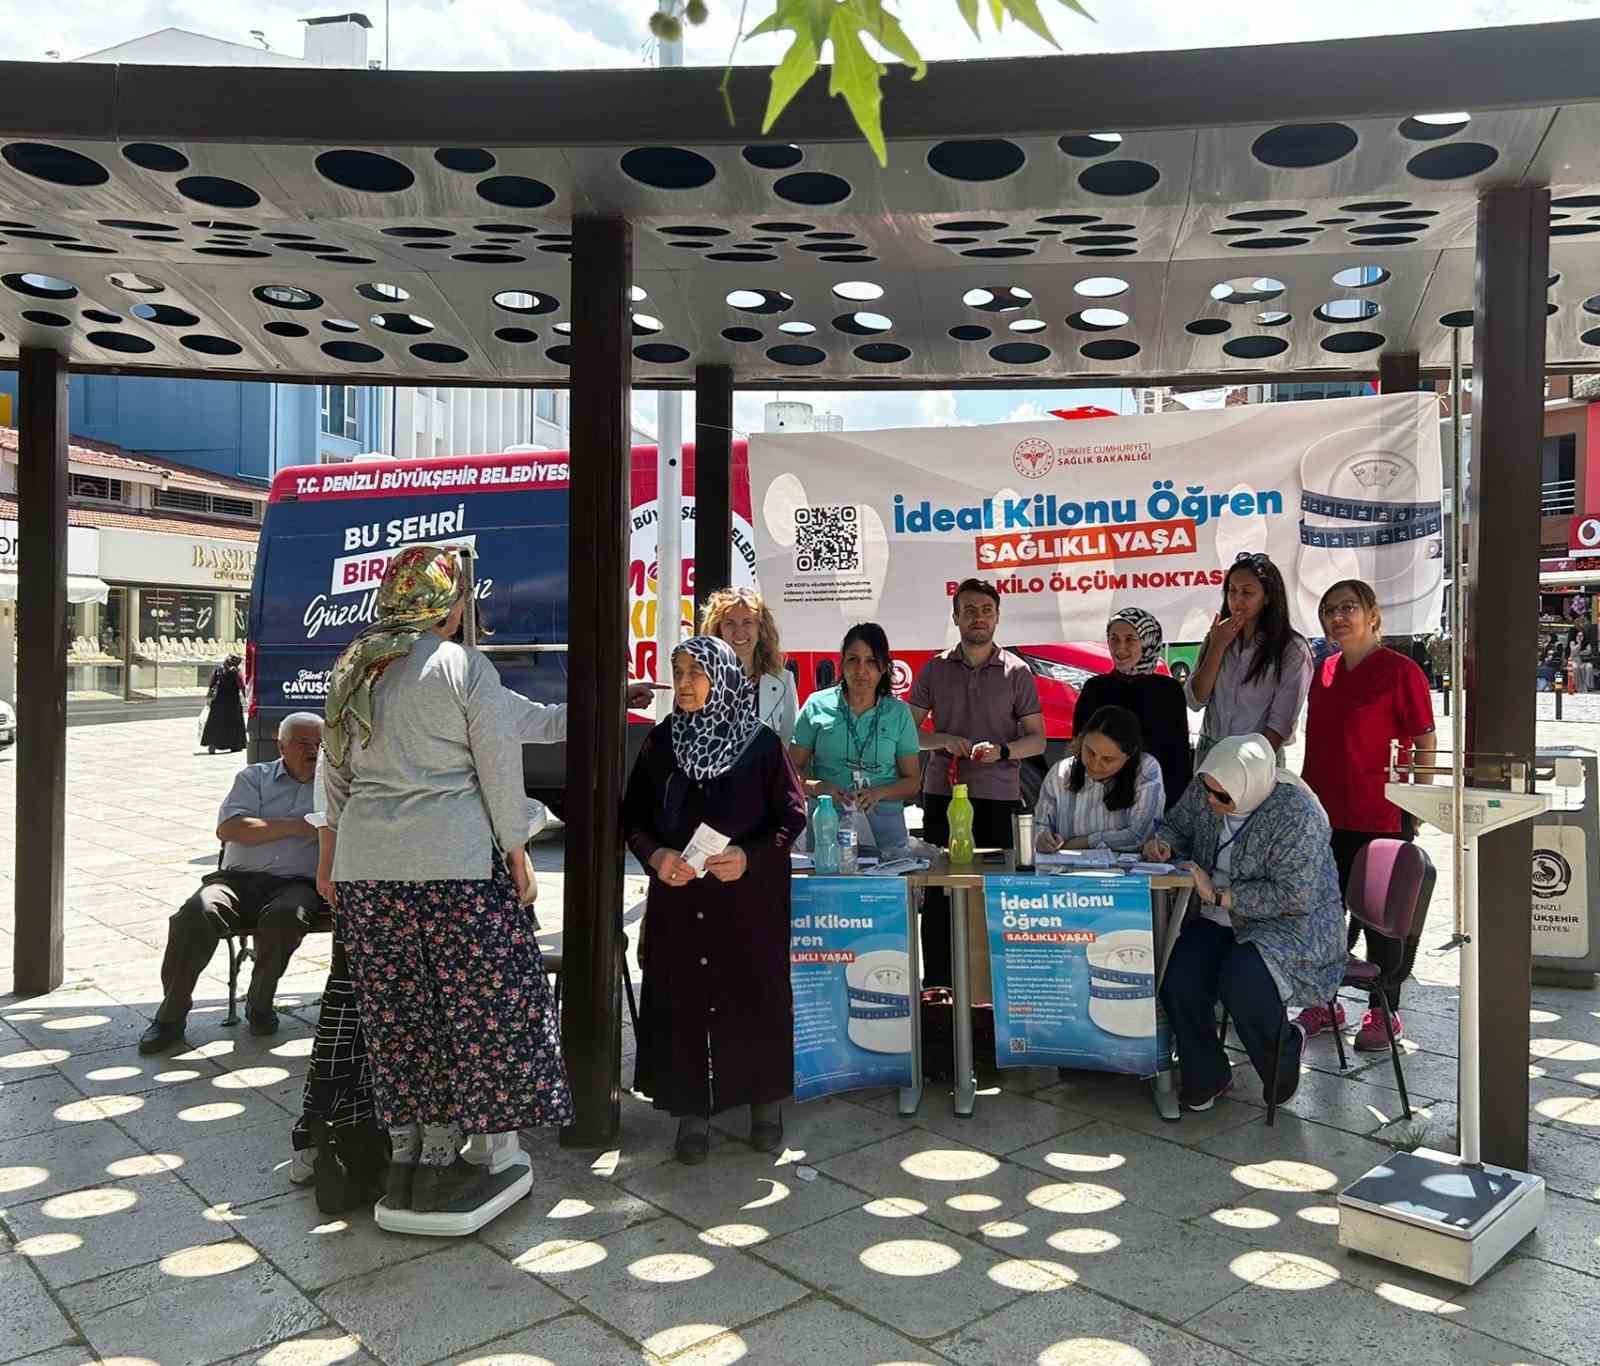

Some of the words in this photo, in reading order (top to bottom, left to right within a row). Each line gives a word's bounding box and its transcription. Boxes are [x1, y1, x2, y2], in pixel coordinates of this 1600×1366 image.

[1057, 455, 1094, 466] SAĞLIK
[1096, 451, 1152, 464] BAKANLIĞI
[1058, 446, 1091, 456] TÜRKİYE
[296, 478, 320, 494] T.C.
[323, 470, 381, 491] DENİZLİ
[382, 464, 477, 489] BÜYÜKŞEHİR
[480, 460, 569, 484] BELEDİYES
[894, 494, 992, 533] İdeal
[1003, 495, 1136, 530] Kilonu
[1147, 480, 1283, 526] Öğren
[344, 524, 379, 551] BU
[386, 503, 464, 547] ŞEHRİ
[979, 533, 1106, 562] SAĞLIKLI
[1113, 526, 1193, 555] YAŞA
[996, 574, 1044, 593] KİLO
[1048, 569, 1127, 594] ÖLÇÜM
[1001, 891, 1049, 910] İdeal
[1052, 892, 1115, 909] Kilonu
[815, 914, 873, 929] Kilonu
[1002, 911, 1063, 930] Öğren
[1006, 931, 1057, 941] SAĞLIKLI
[1058, 932, 1094, 943] YAŞA!
[819, 952, 854, 963] YAŞA!
